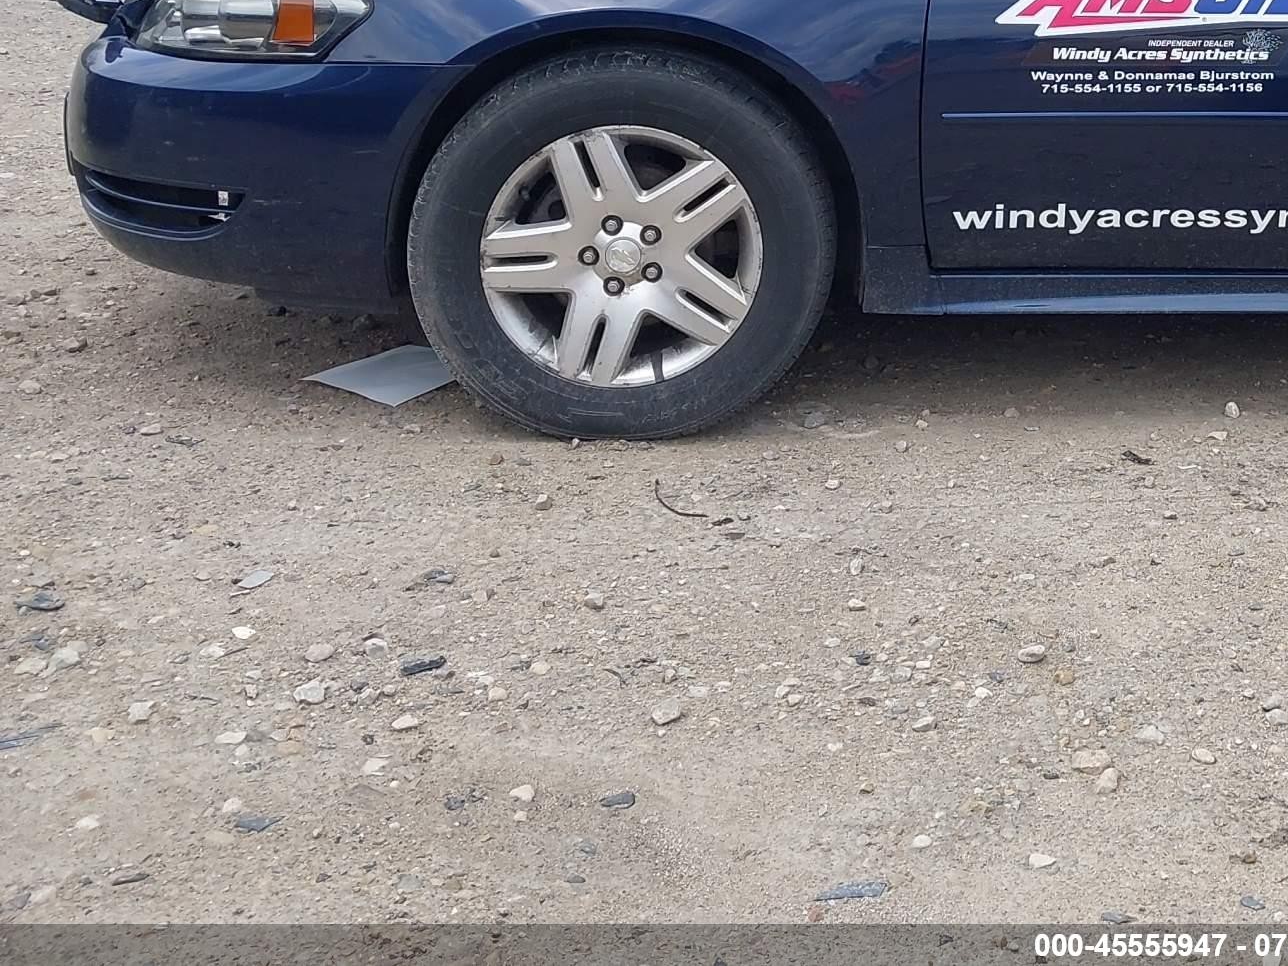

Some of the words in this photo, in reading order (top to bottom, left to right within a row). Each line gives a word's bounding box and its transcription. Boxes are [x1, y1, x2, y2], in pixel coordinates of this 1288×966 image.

[1147, 39, 1202, 48] INDEPENDENT
[1203, 39, 1235, 48] DEALER
[1053, 47, 1111, 63] Windy
[1113, 47, 1167, 61] Acres
[1169, 47, 1270, 64] Synthetics
[1031, 70, 1093, 83] Waynne
[1097, 70, 1109, 81] &
[1114, 70, 1195, 81] Donnamae
[1199, 70, 1274, 83] Bjurstrom
[1041, 83, 1142, 94] 715-554-1155
[1145, 85, 1162, 93] or
[1166, 83, 1263, 93] 715-554-1156
